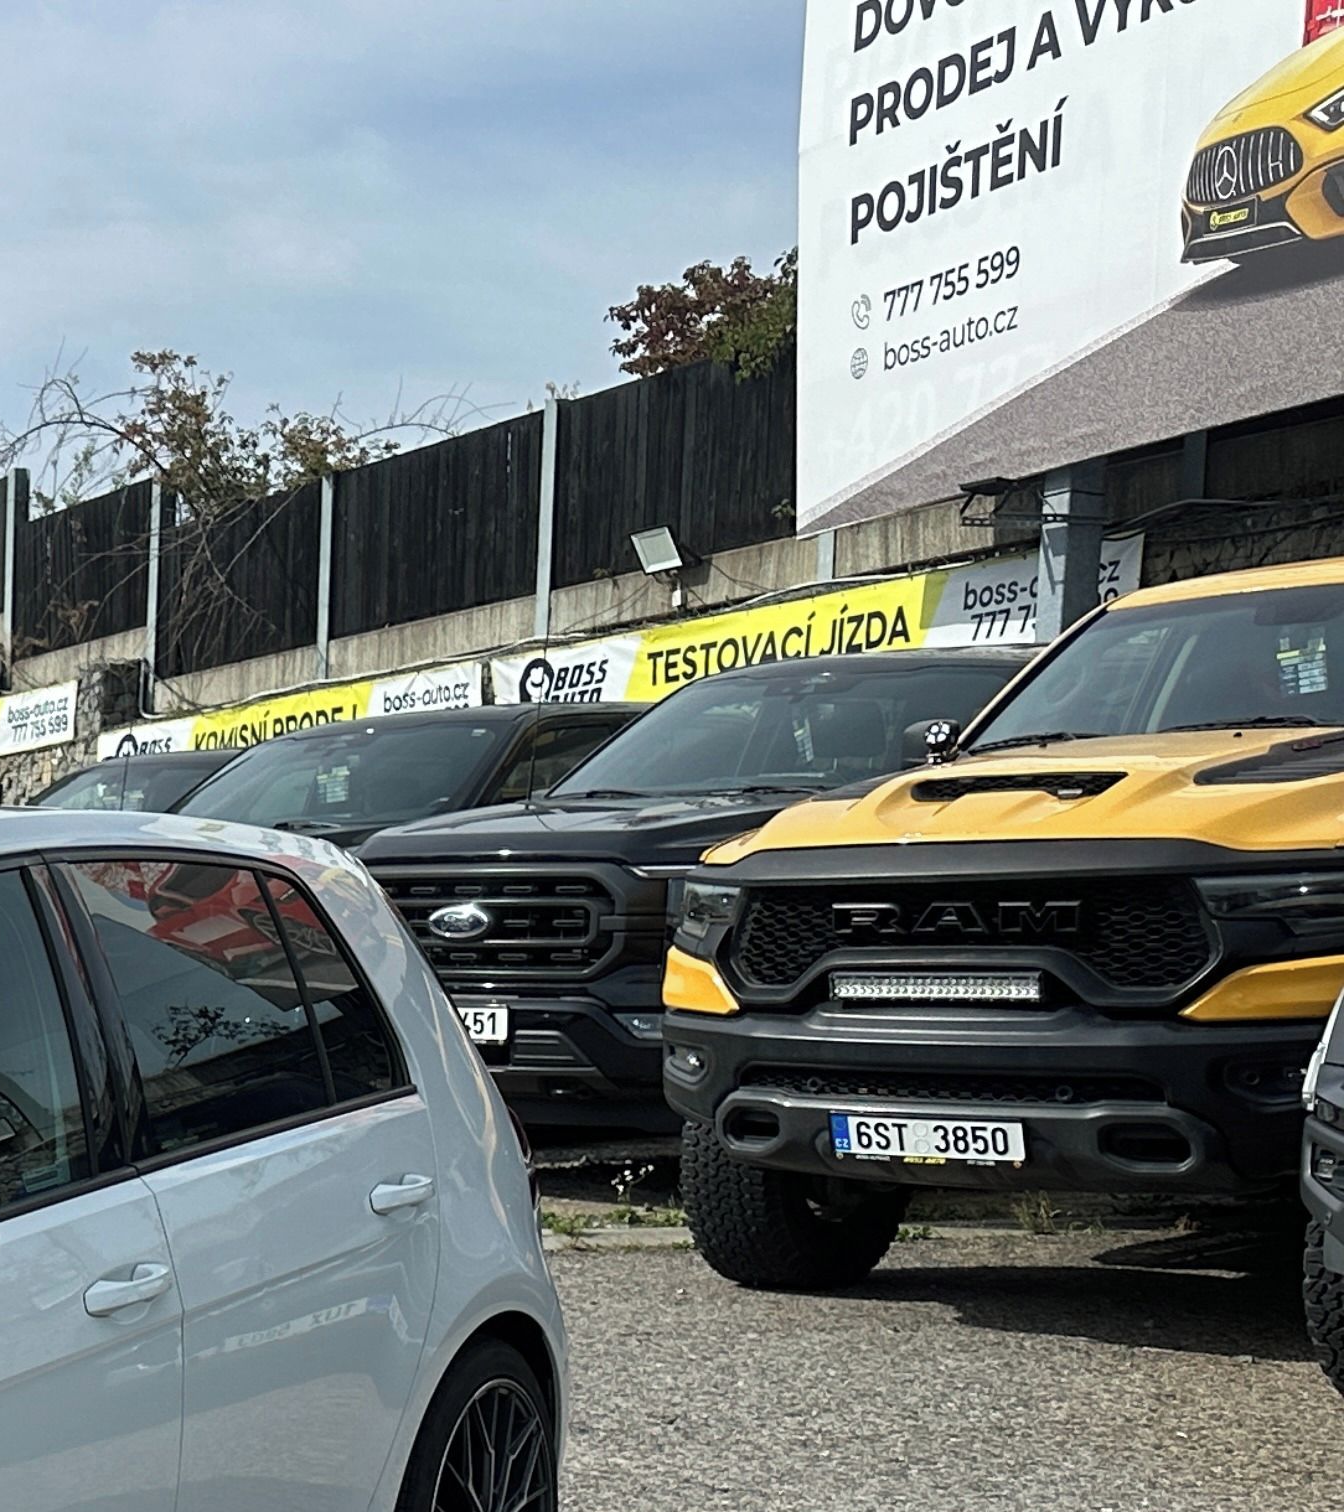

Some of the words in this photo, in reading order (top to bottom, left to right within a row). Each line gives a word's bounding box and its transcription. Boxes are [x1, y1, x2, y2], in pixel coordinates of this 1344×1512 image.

[849, 25, 1017, 147] PRODEJ
[1026, 10, 1062, 71] A
[850, 95, 1069, 245] POJIŠTĚNÍ
[883, 280, 925, 322] 777
[930, 264, 970, 306] 755
[976, 246, 1021, 291] 599
[883, 304, 1019, 371] boss-auto.cz
[647, 612, 814, 686] TESTOVACÍ
[819, 604, 911, 656] JÍZDA
[553, 658, 609, 692] BOSS
[7, 697, 69, 724] boss-auto.cz
[384, 682, 470, 713] boss-auto.cz
[832, 902, 1080, 935] RAM
[835, 1138, 849, 1148] CZ
[856, 1121, 908, 1151] 6ST
[932, 1124, 1009, 1156] 3850
